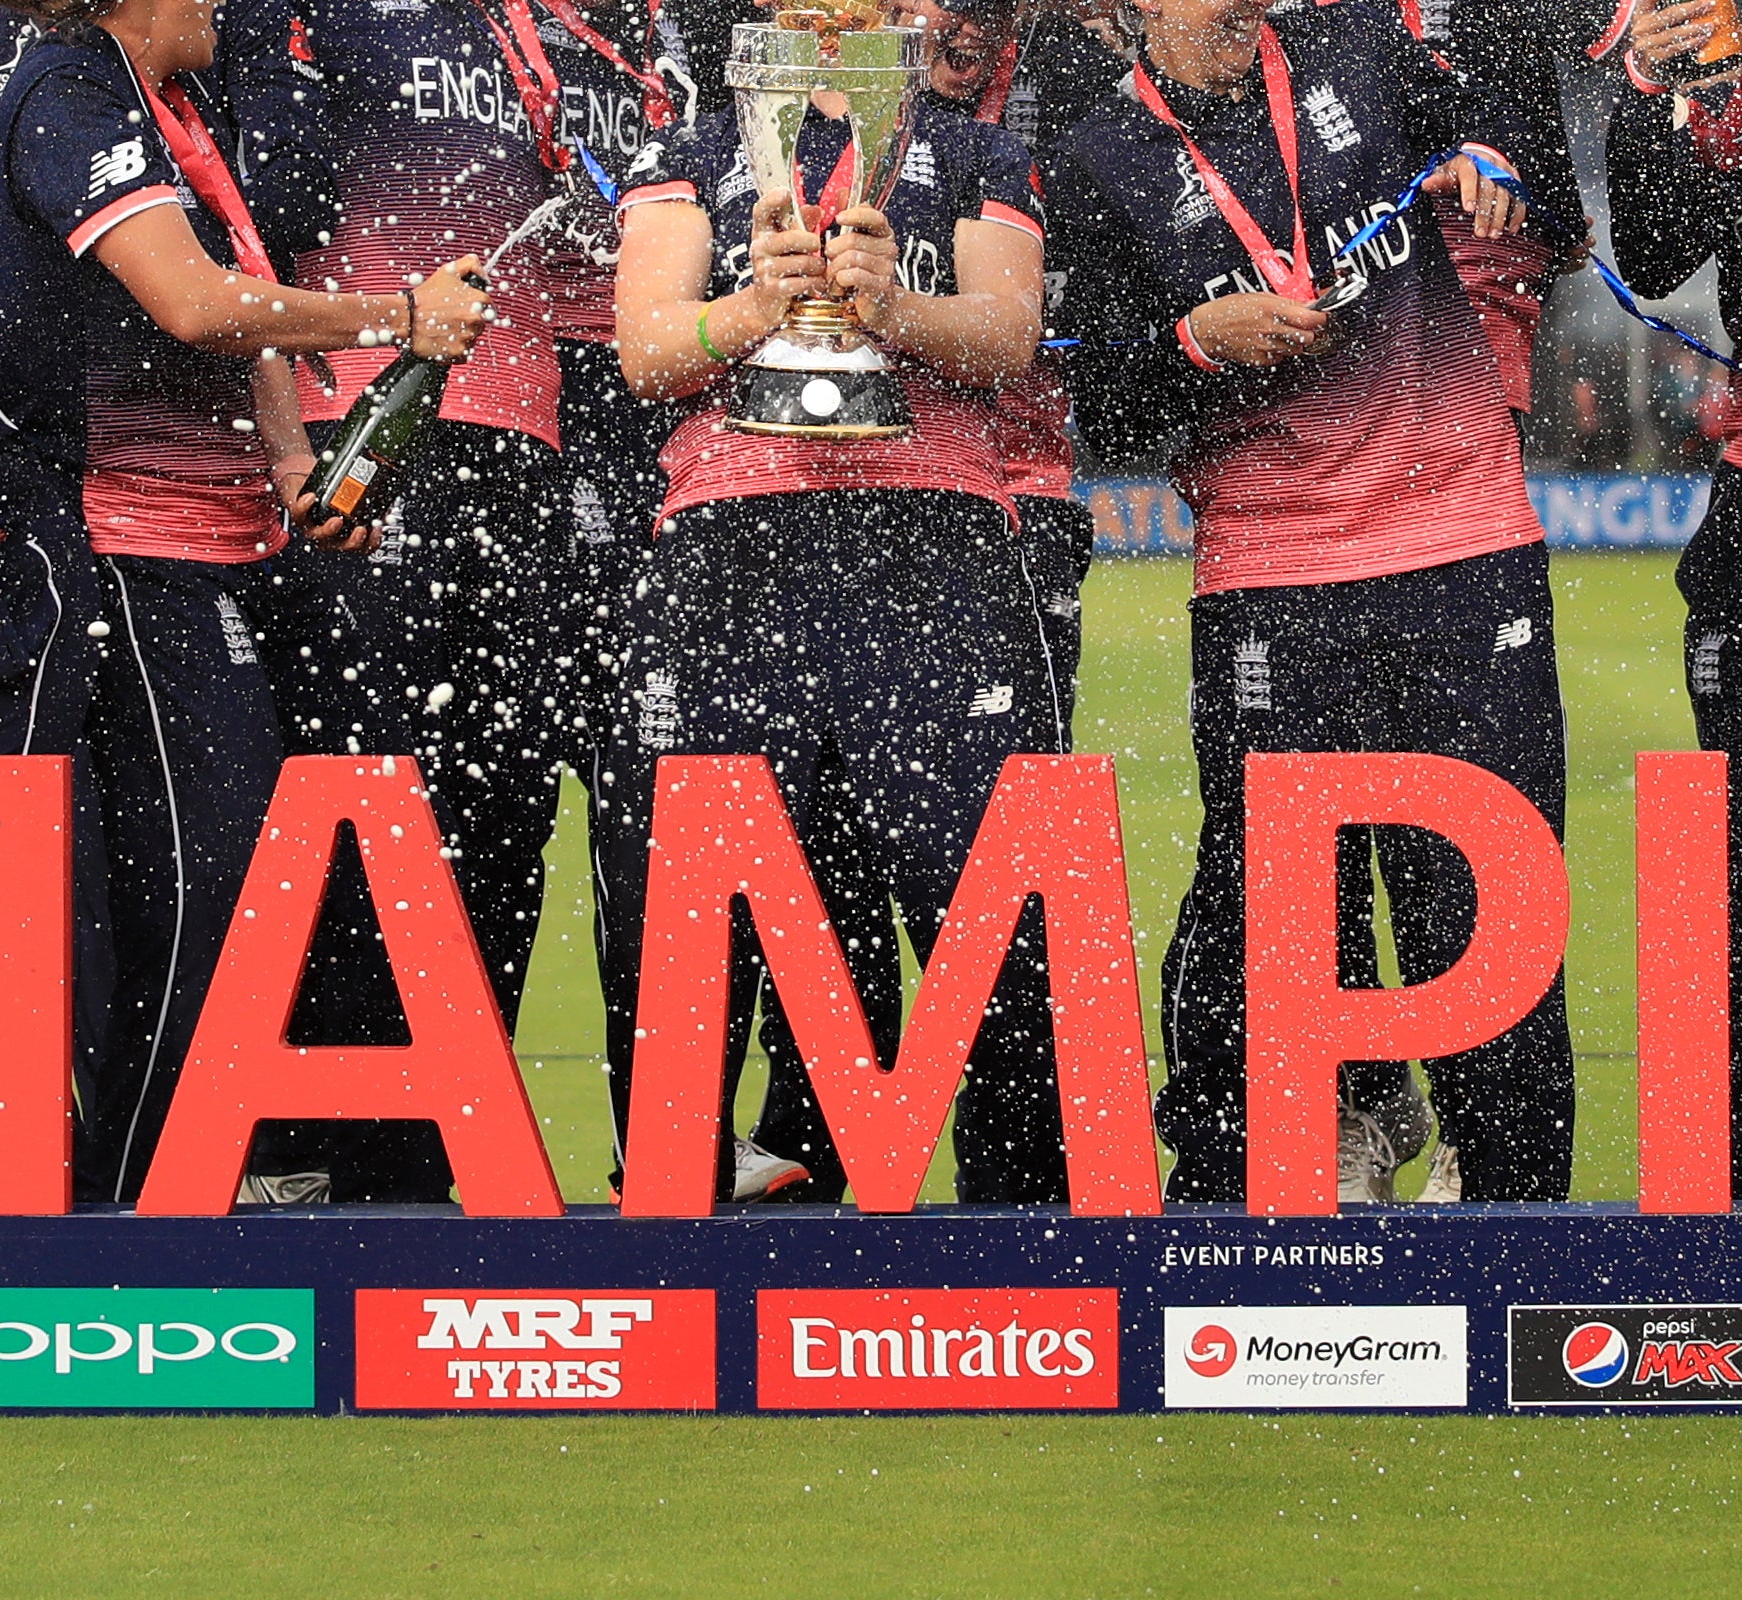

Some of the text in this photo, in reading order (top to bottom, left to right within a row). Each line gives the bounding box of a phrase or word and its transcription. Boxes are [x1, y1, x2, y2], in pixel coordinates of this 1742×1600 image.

[1165, 1245, 1385, 1266] EVENT PARTNERS
[417, 1299, 652, 1349] MRF
[1643, 1318, 1695, 1338] pepsi
[789, 1315, 1094, 1378] Emirates
[1246, 1336, 1441, 1368] MoneyGram
[447, 1360, 621, 1398] TYRES
[1246, 1369, 1386, 1390] money transfer
